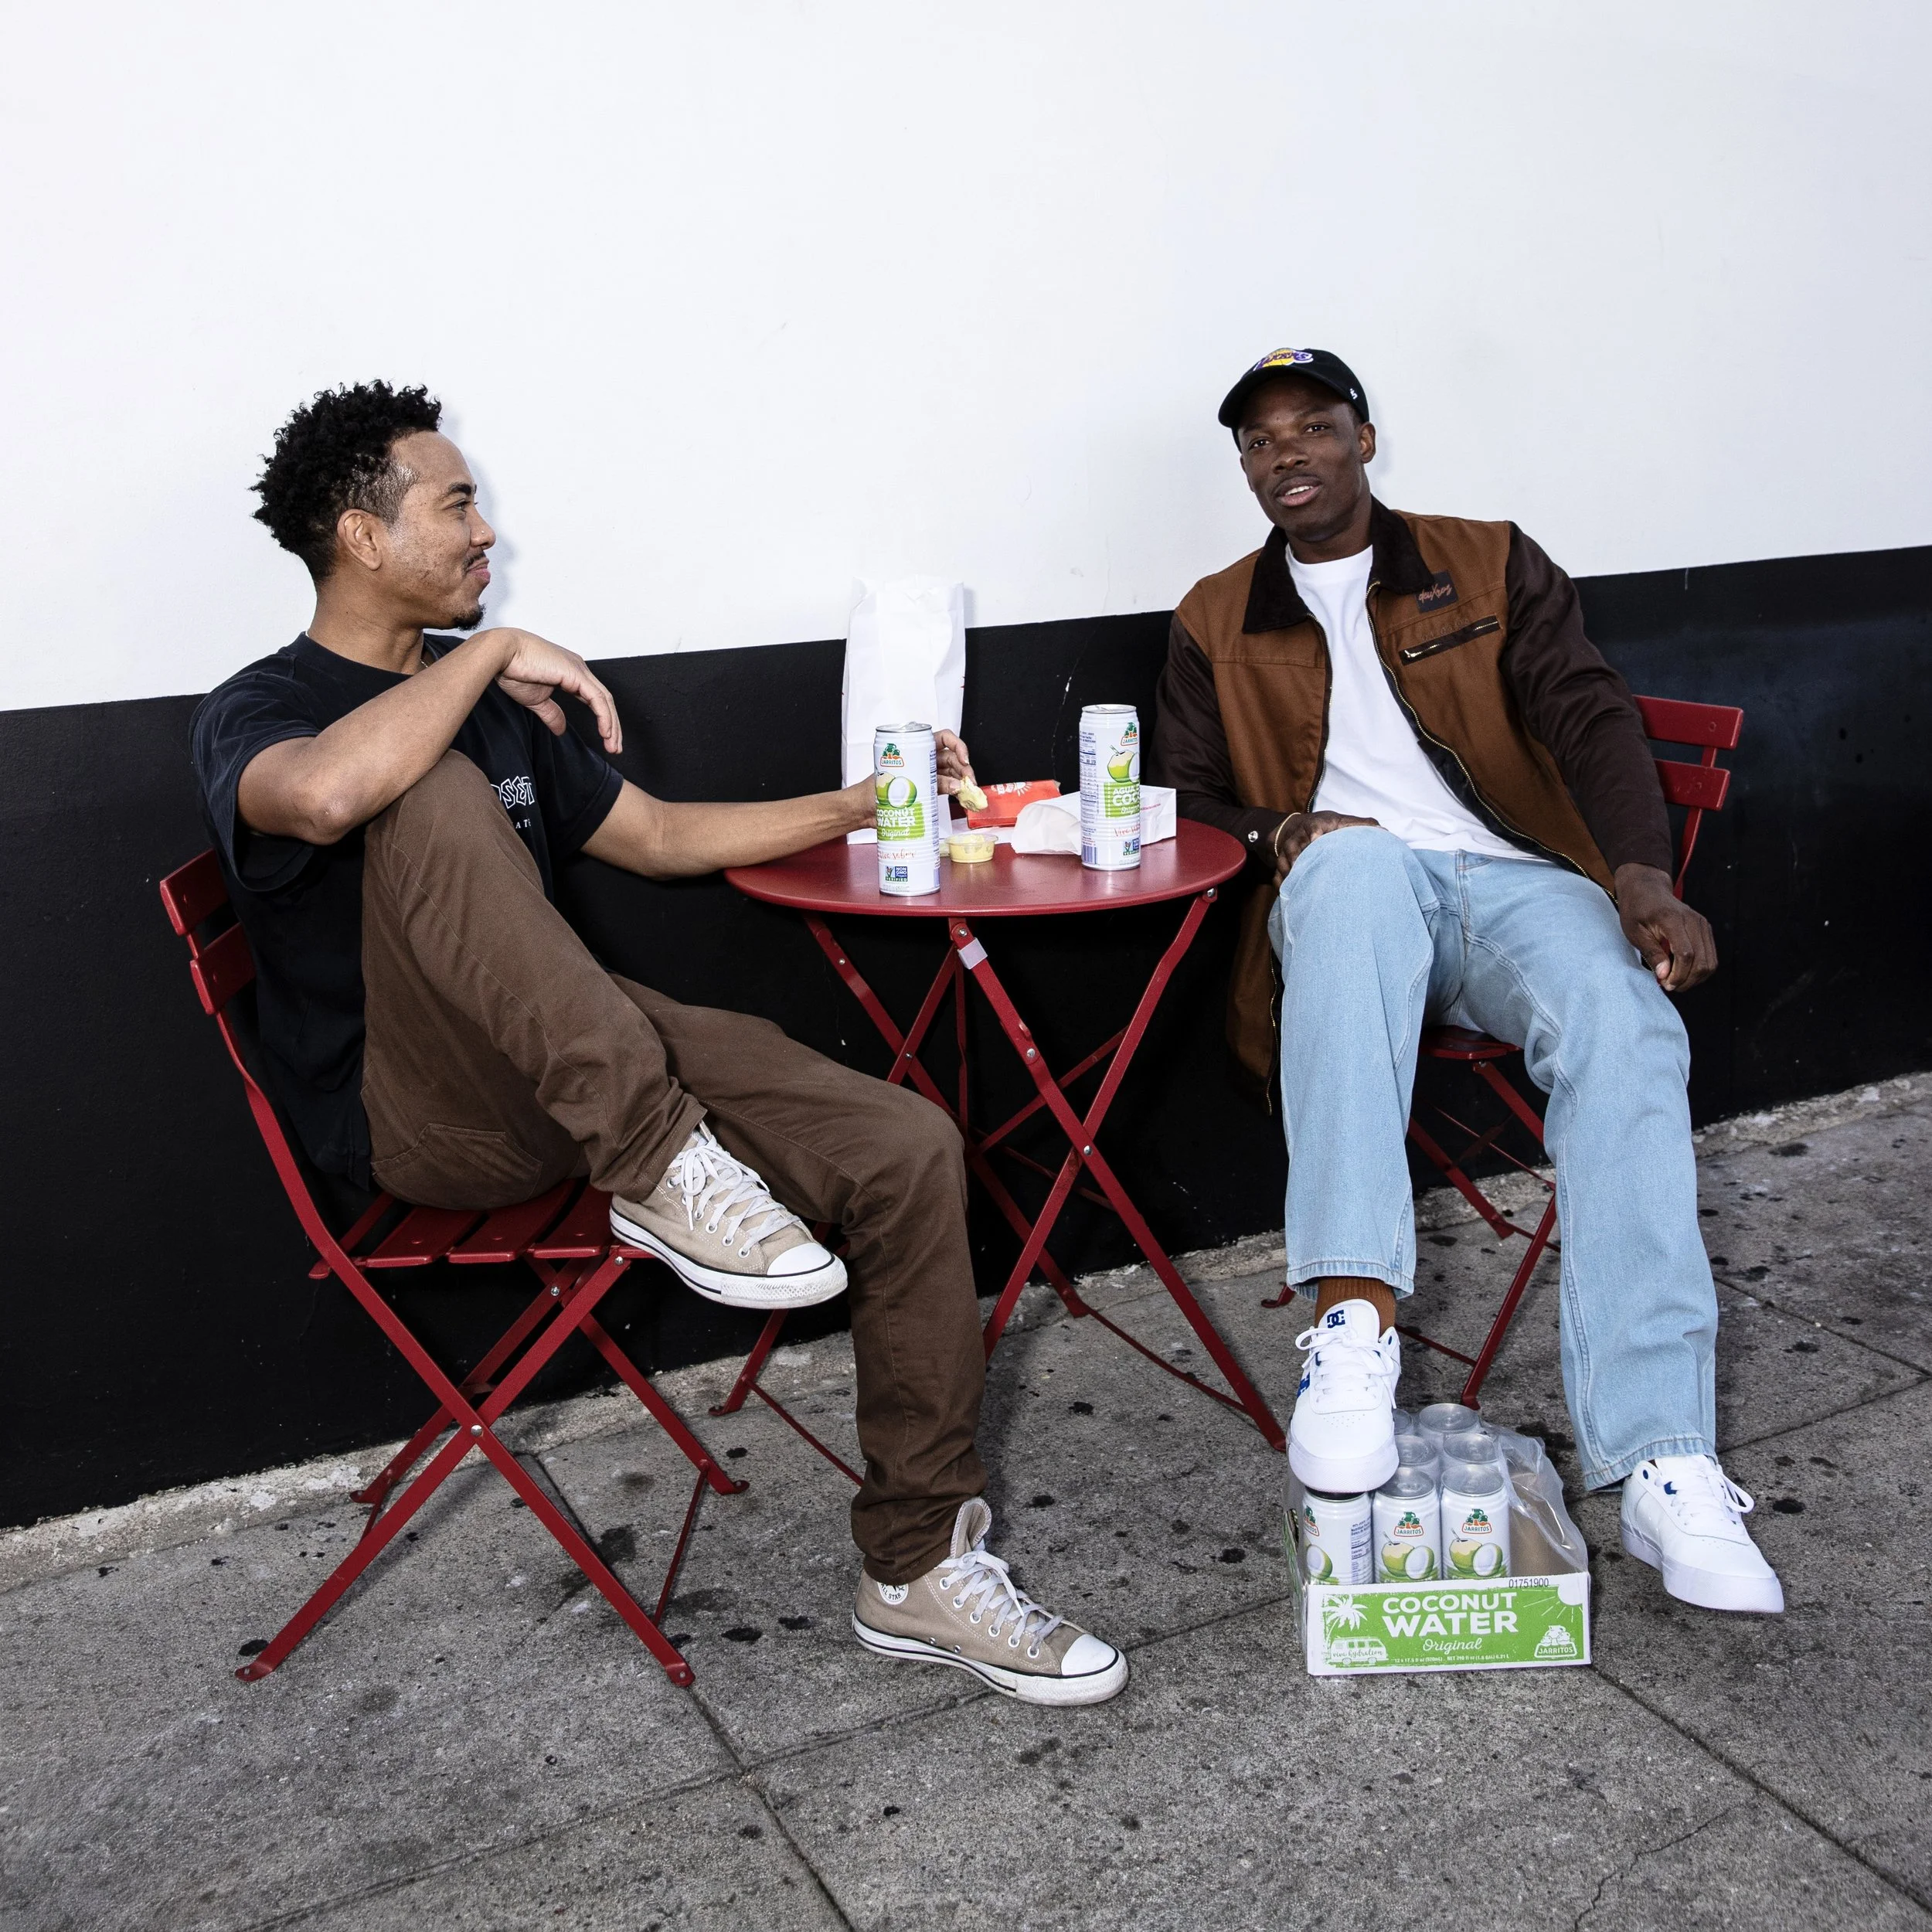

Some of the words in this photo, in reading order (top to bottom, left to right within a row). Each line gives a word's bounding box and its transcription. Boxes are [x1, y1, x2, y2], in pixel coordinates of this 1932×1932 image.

[1327, 1310, 1345, 1328] DC
[1509, 1578, 1549, 1589] 01751900
[1383, 1592, 1518, 1614] COCONUT
[1382, 1611, 1519, 1638] WATER
[1348, 1648, 1383, 1658] hydration
[1423, 1638, 1482, 1655] Original
[1539, 1646, 1573, 1655] JARRITOS
